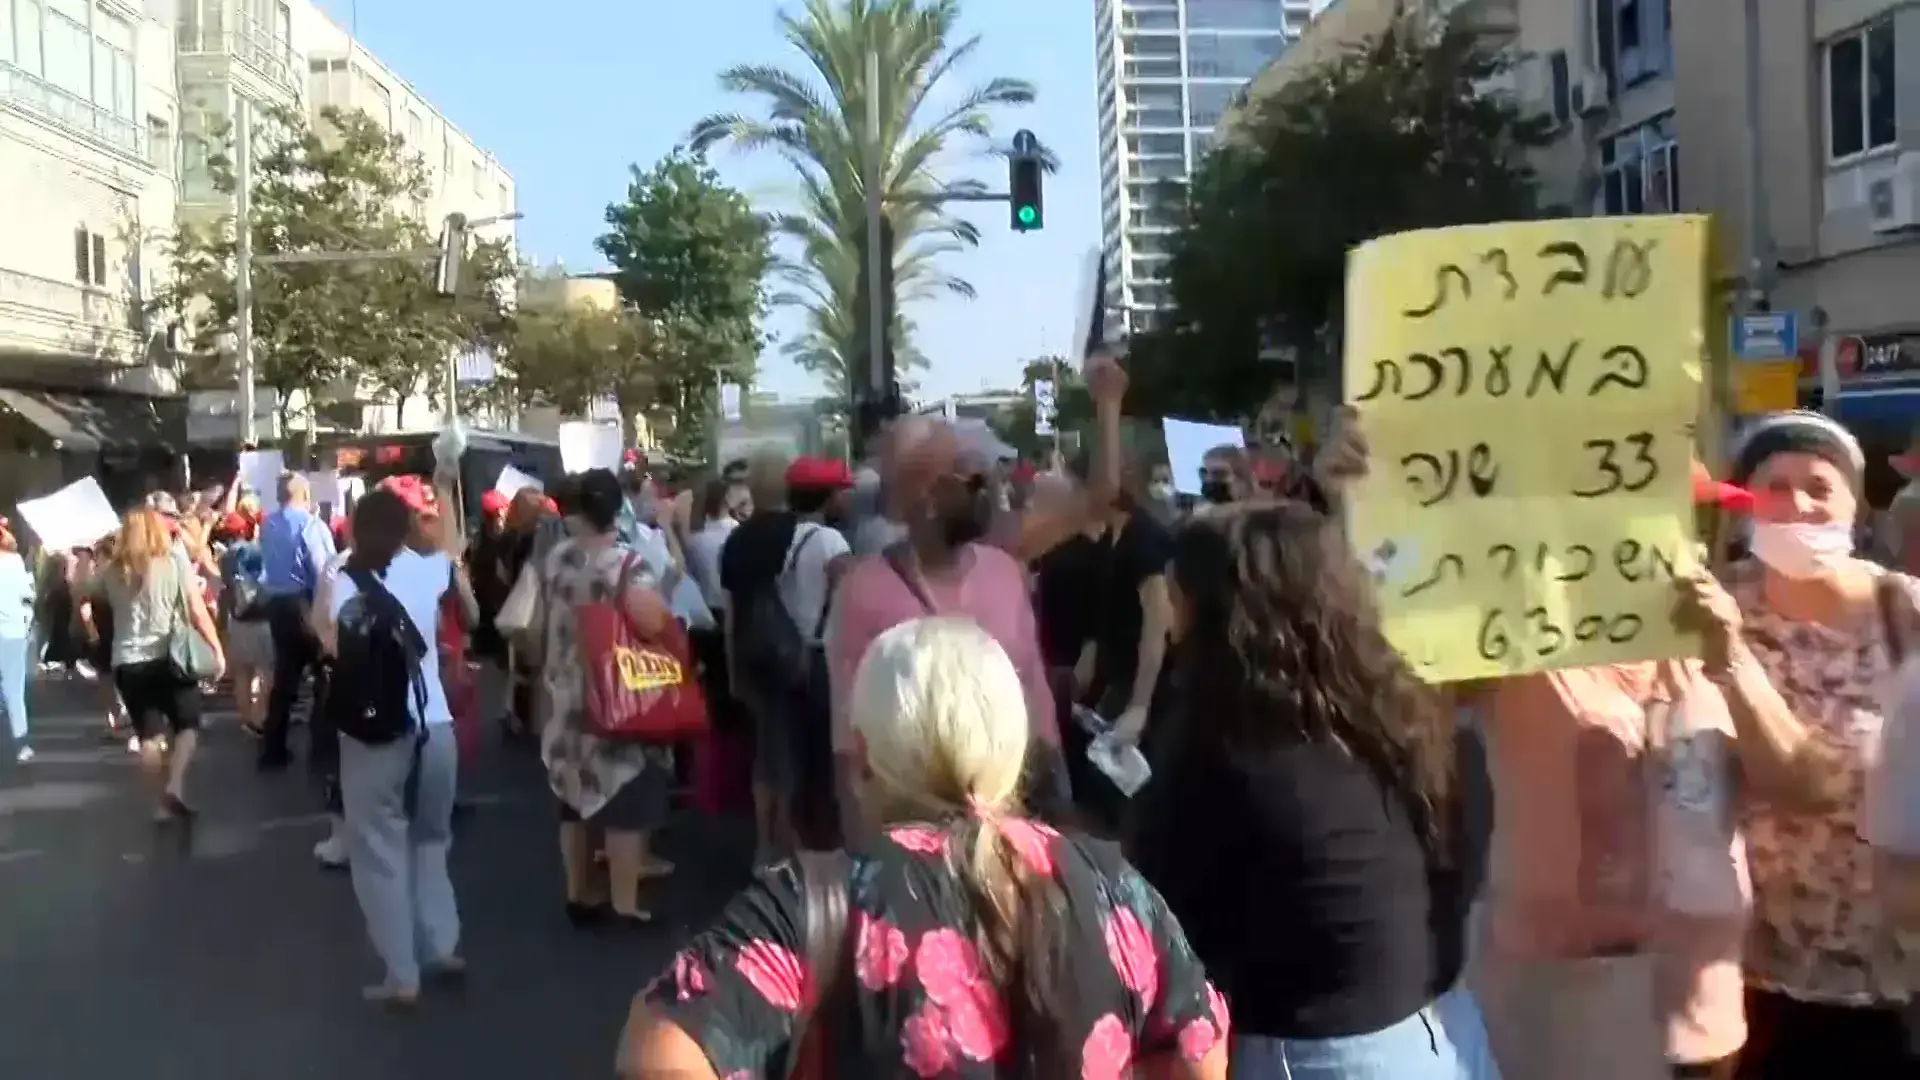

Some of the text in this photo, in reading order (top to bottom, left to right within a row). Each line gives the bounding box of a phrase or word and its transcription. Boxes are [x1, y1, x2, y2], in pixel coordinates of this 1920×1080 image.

[1354, 338, 1650, 402] במערכת
[1401, 432, 1660, 508] 33 שנה
